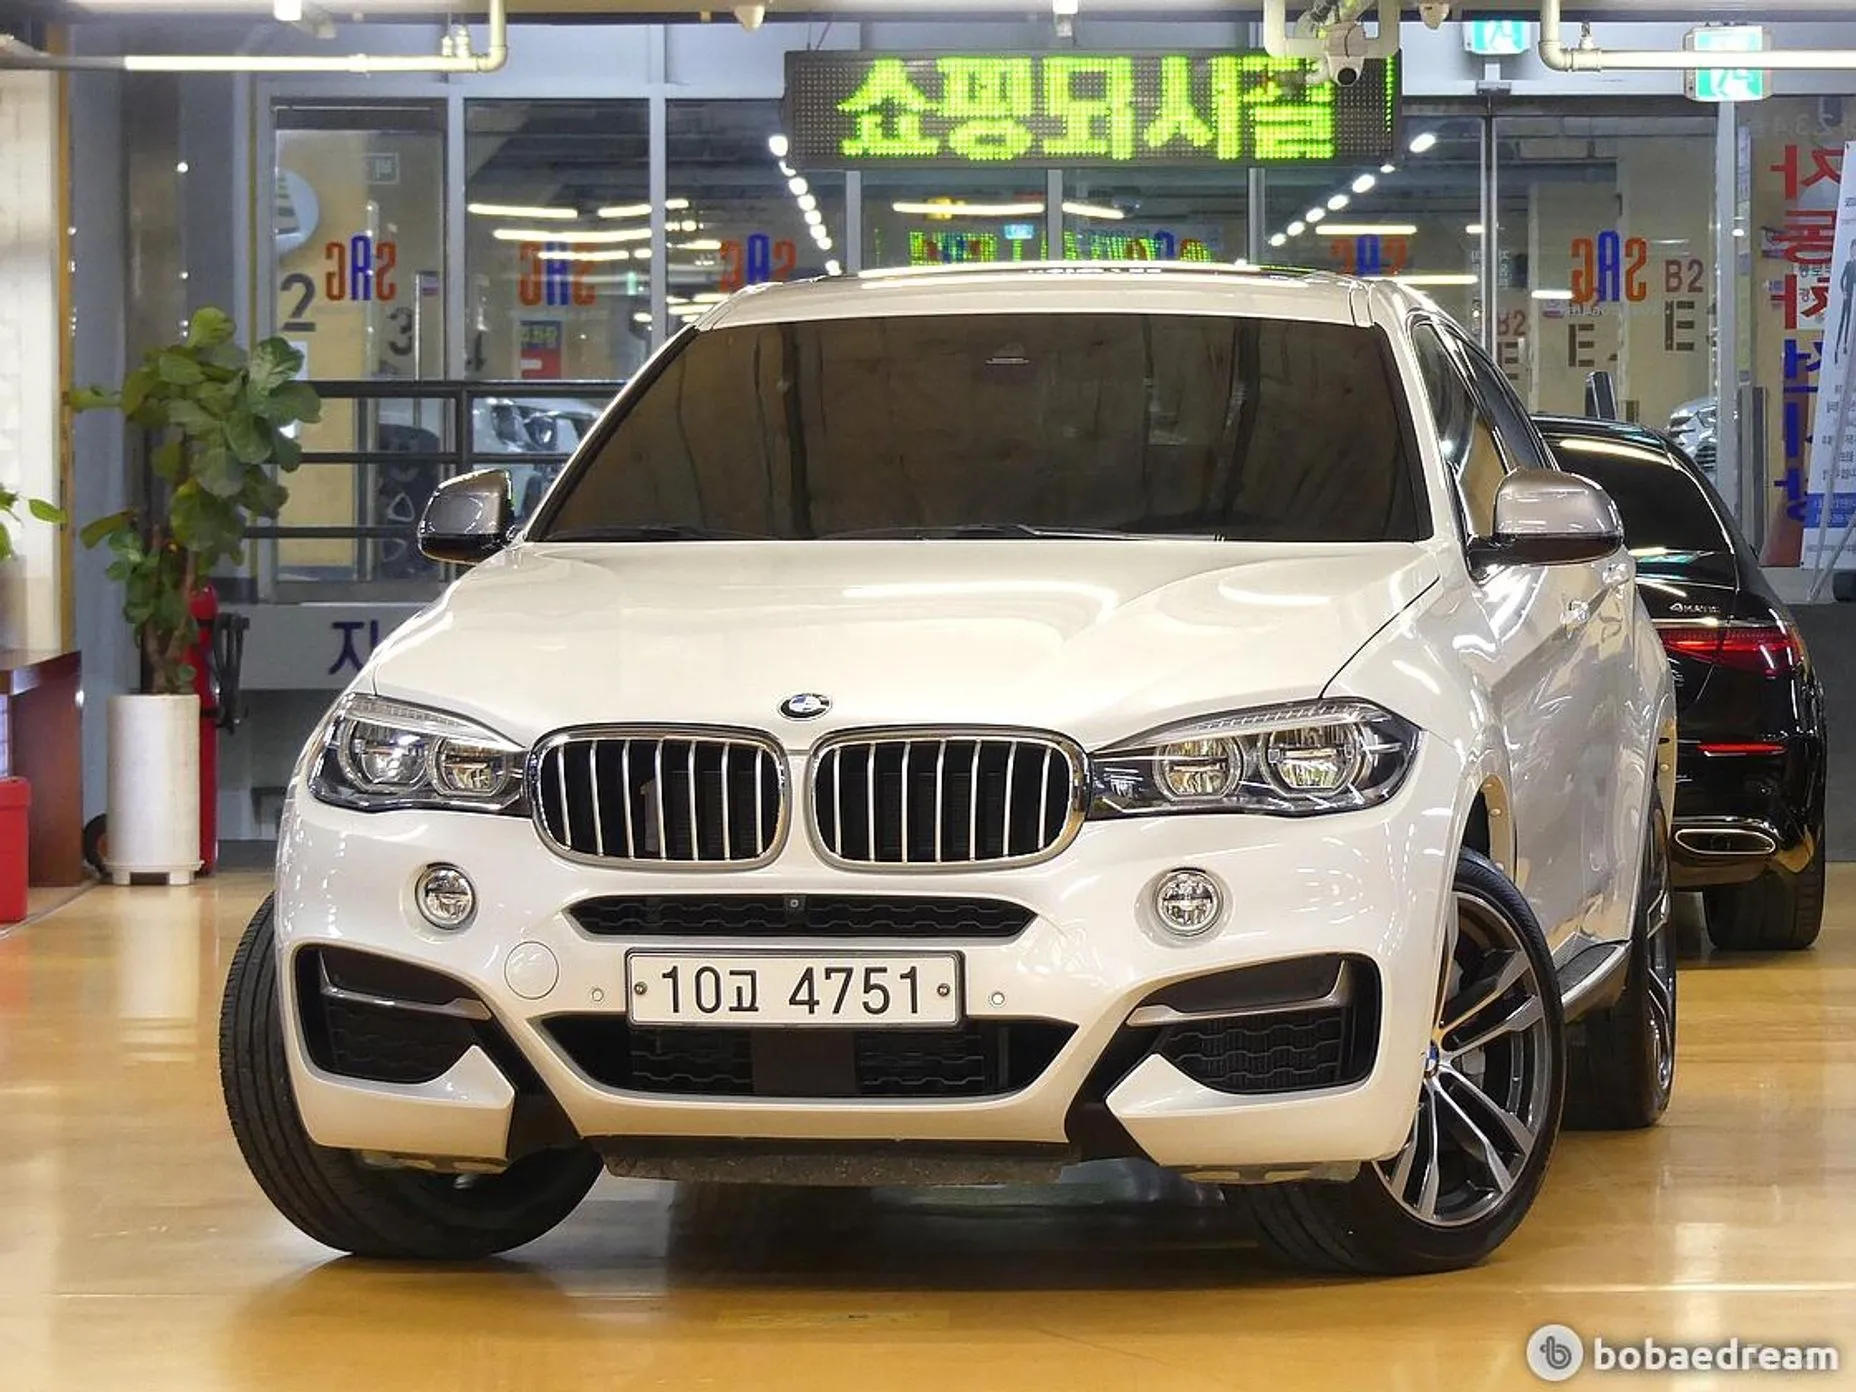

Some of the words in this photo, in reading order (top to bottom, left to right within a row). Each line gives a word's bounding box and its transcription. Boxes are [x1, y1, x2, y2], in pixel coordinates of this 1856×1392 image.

[1665, 258, 1704, 293] B2
[279, 272, 317, 332] 2
[387, 306, 412, 356] 3
[662, 966, 759, 1014] 10고
[789, 966, 920, 1015] 4751
